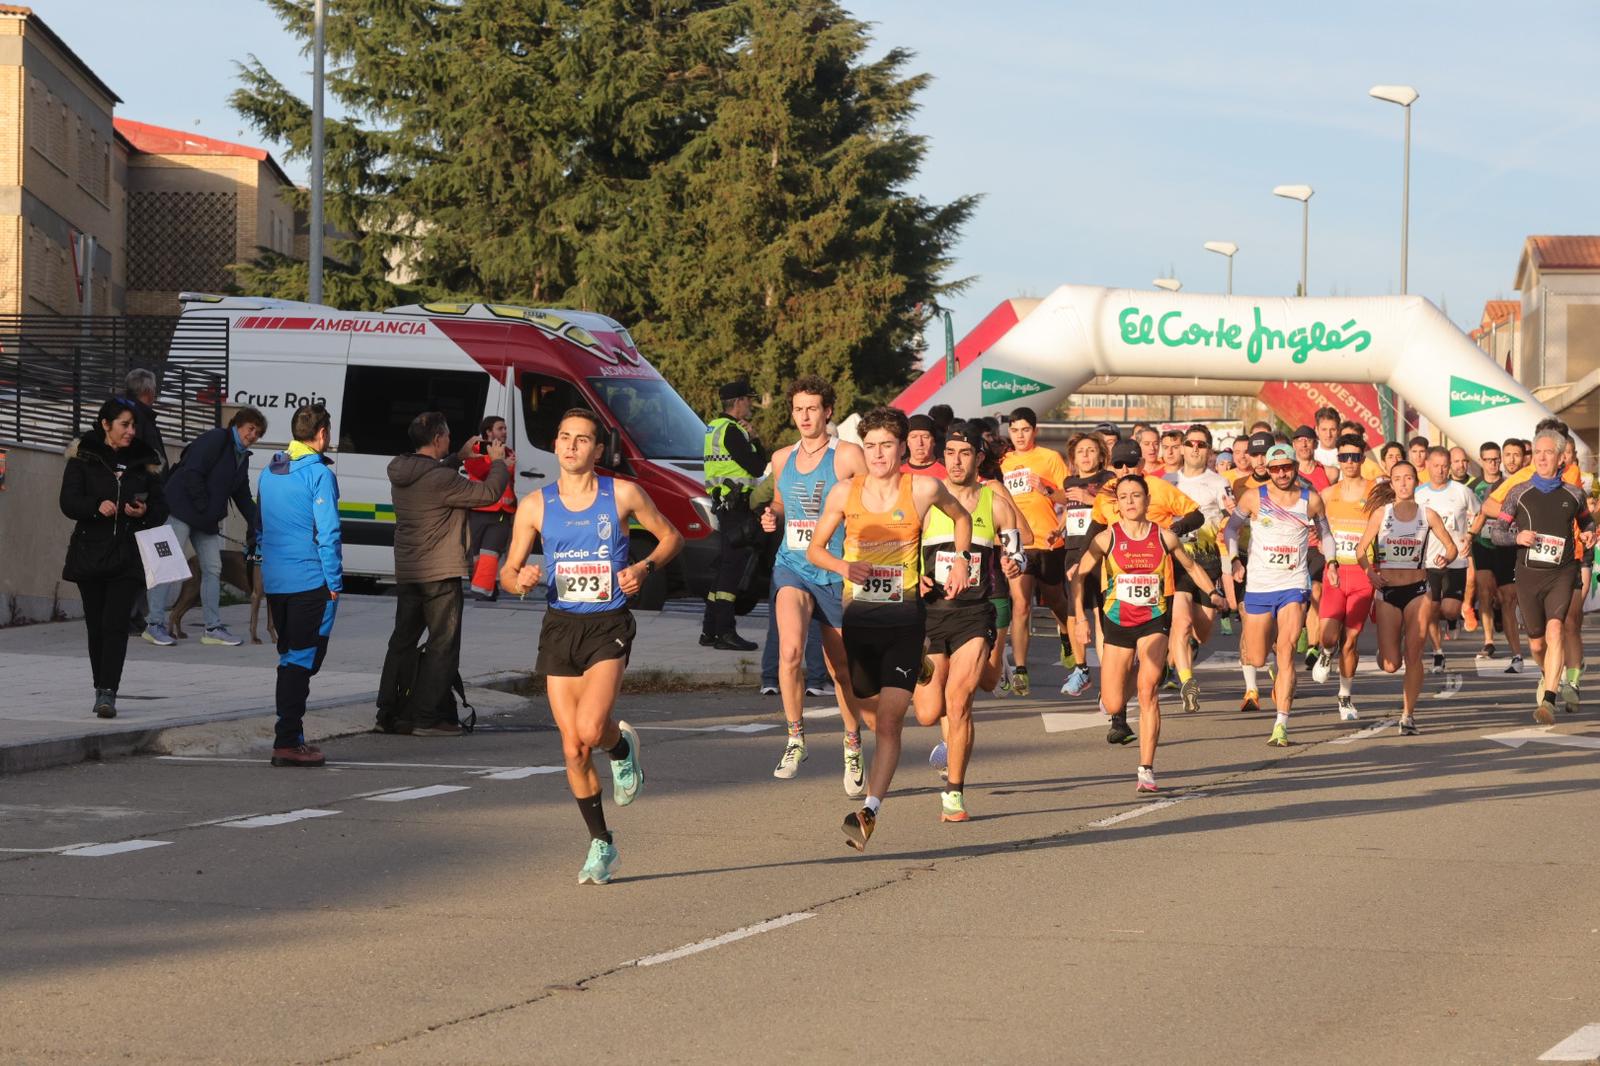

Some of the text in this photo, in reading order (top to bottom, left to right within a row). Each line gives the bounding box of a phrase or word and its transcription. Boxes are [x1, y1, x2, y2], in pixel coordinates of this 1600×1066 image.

[312, 318, 427, 335] AMBULANCIA
[1119, 306, 1372, 364] El Corte Inglés
[234, 390, 279, 408] Cruz
[1324, 381, 1385, 436] UESTROS
[1008, 477, 1025, 490] 166
[1078, 518, 1084, 529] 8
[1392, 545, 1415, 557] 307
[1535, 543, 1558, 556] 398
[1268, 553, 1291, 565] 221
[557, 563, 610, 575] bedunia
[566, 575, 600, 592] 293
[862, 577, 893, 593] 395
[1126, 585, 1152, 598] 158
